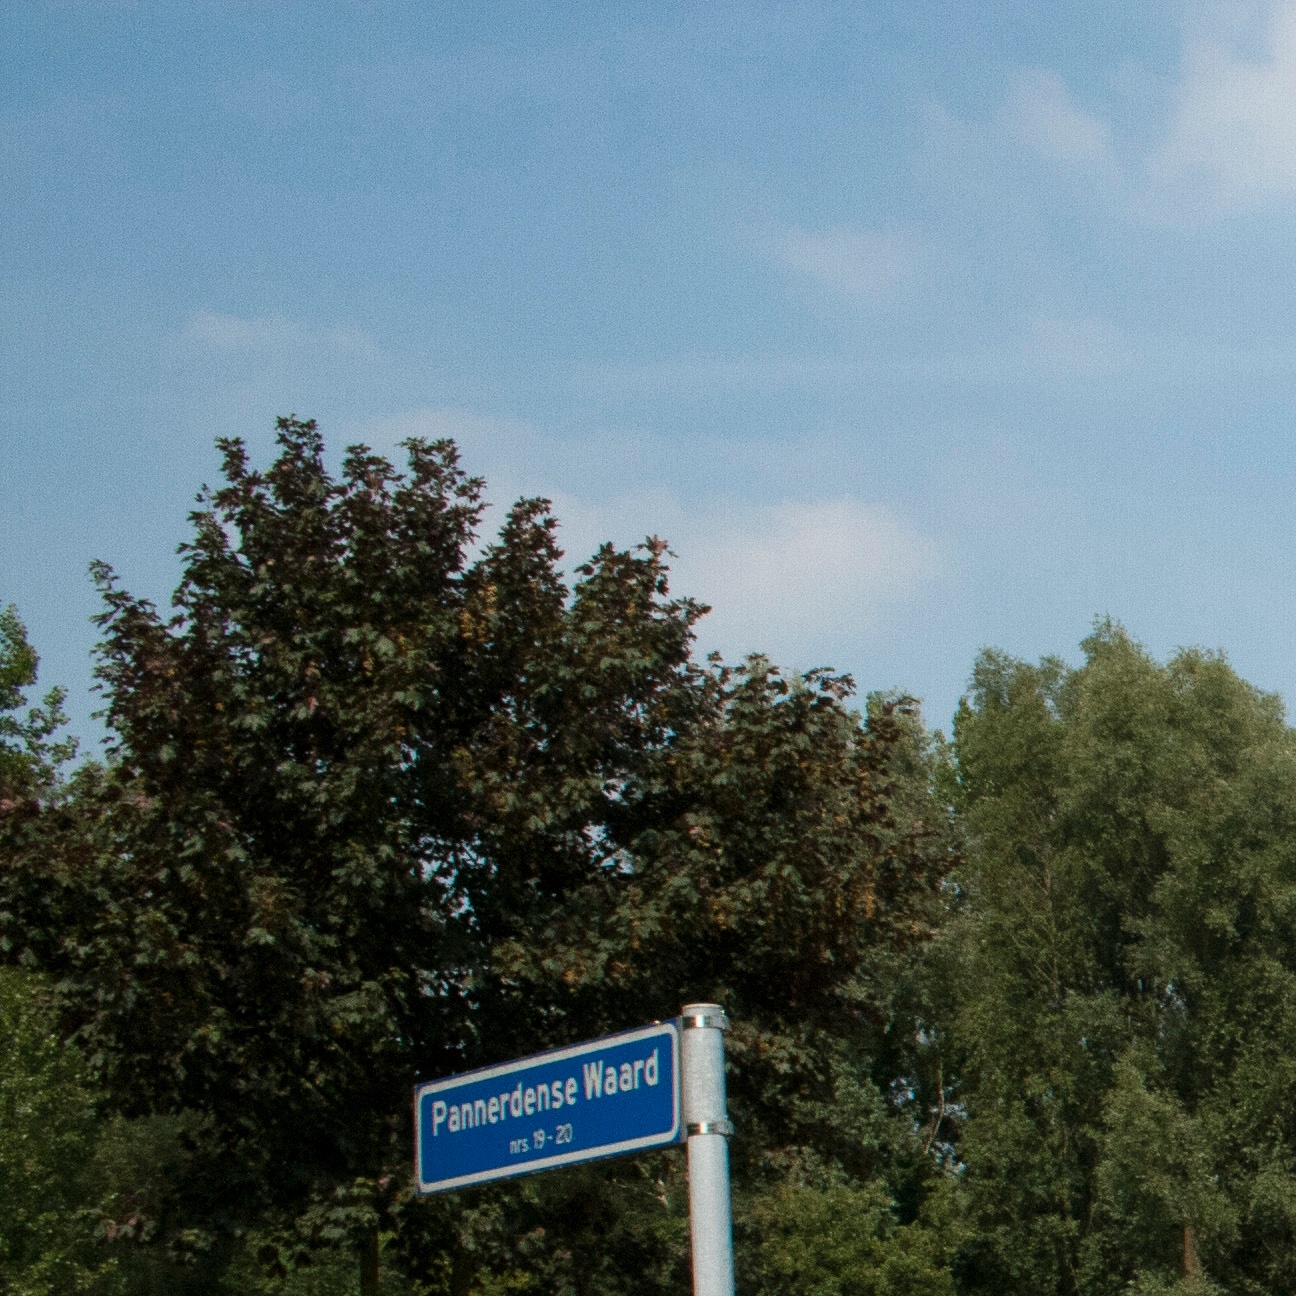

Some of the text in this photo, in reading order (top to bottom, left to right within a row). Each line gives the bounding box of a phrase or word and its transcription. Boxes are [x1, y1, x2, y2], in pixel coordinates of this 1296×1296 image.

[431, 1047, 660, 1137] Pannerdense Waard
[532, 1128, 546, 1150] 19
[555, 1122, 573, 1145] 20
